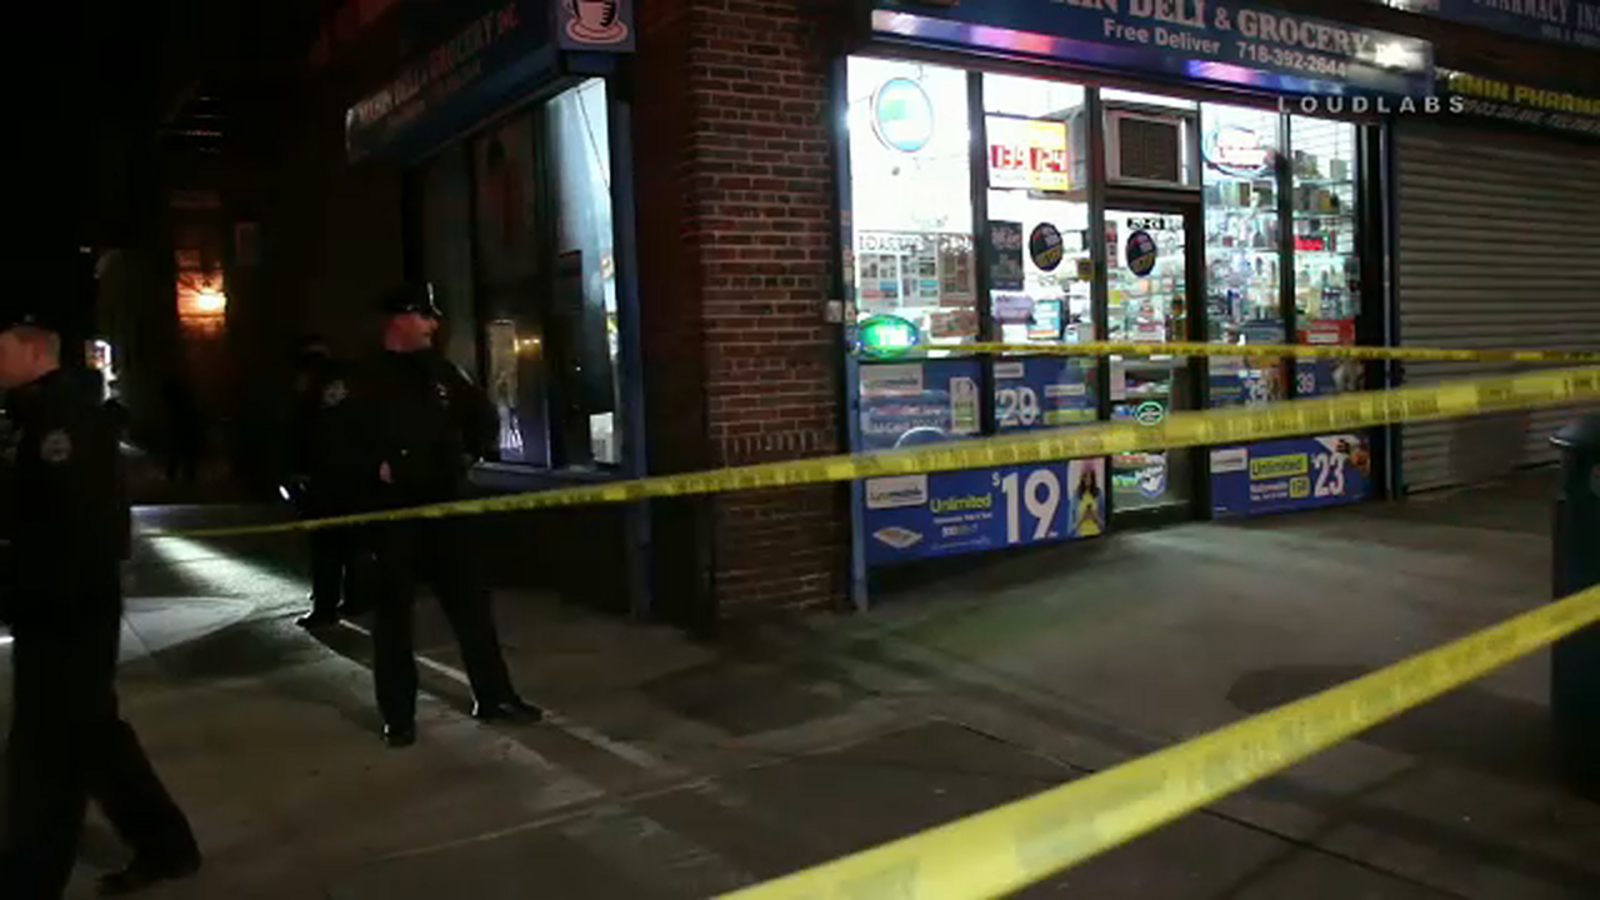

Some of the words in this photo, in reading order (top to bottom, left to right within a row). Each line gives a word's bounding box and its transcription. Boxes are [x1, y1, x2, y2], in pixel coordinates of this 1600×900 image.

[1103, 18, 1149, 43] Free
[1154, 26, 1220, 55] Deliver
[1128, 0, 1206, 27] DELI
[1214, 7, 1231, 30] &
[1237, 9, 1370, 58] GROCERY
[1251, 457, 1303, 477] Unlimited
[930, 492, 992, 513] Unlimited
